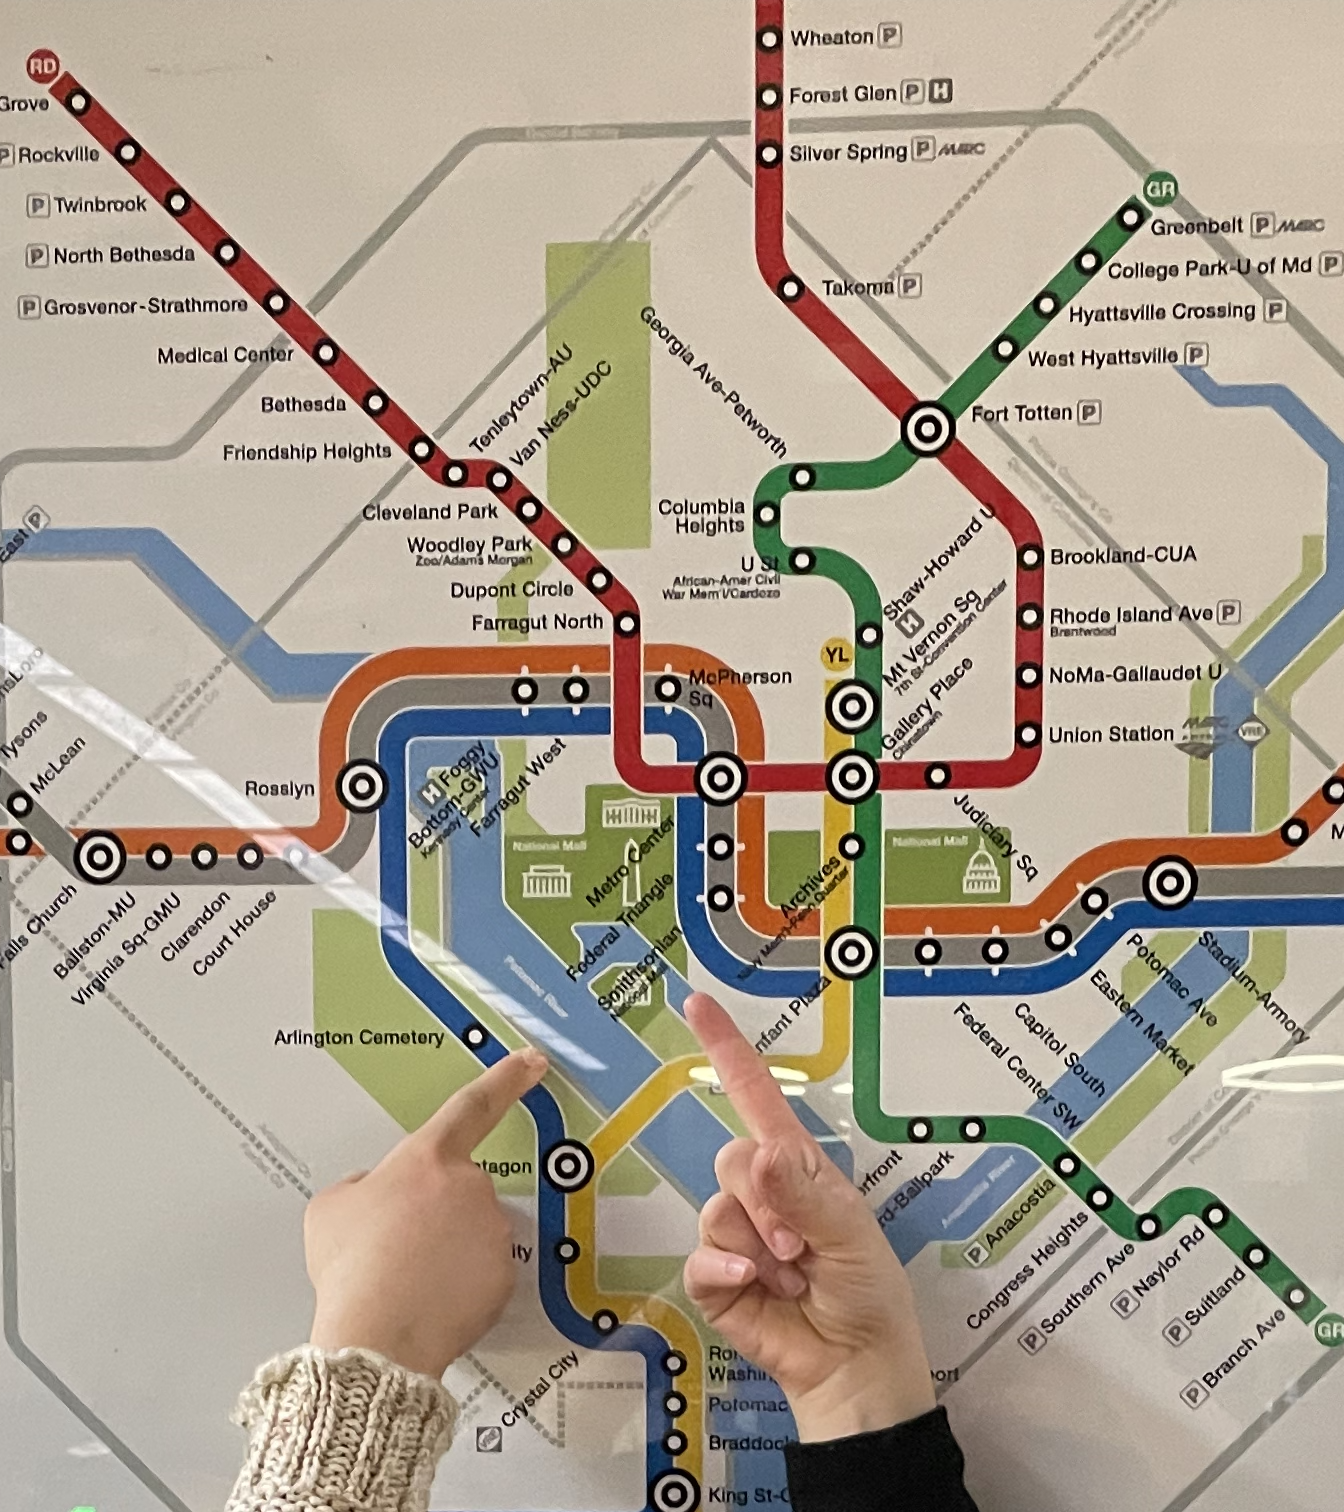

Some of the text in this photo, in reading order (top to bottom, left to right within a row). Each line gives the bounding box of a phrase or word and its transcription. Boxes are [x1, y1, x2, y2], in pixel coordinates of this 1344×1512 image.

[790, 28, 873, 47] Wheaton
[789, 83, 897, 104] Forest Glen
[19, 147, 99, 163] Rockville
[789, 142, 908, 165] Silver Spring
[54, 196, 147, 213] Twinbrook
[1151, 217, 1244, 237] Greenbelt
[822, 279, 895, 297] Takoma
[45, 299, 247, 316] Grosvenor-Strathmore
[1069, 301, 1256, 325] Hyattsville Crossing
[158, 346, 293, 364] Medical Center
[261, 396, 346, 413] Bethesda
[971, 403, 1073, 422] Fort Totten
[224, 443, 391, 463] Friendship Heights
[362, 503, 498, 521] Cleveland Park
[658, 499, 746, 517] Columbia
[675, 517, 745, 536] Heights
[407, 536, 532, 555] Woodley Park
[1050, 545, 1197, 566] Brookland-CUA
[450, 581, 574, 600] Dupont Circle
[1050, 606, 1214, 625] Rhode Island Ave
[1050, 626, 1117, 638] Brentwood
[689, 668, 792, 687] McPherson
[1049, 664, 1223, 684] NoMa-Gallaudet U
[689, 691, 713, 709] Sq
[881, 656, 974, 753] Gallery Place
[1049, 726, 1174, 744] Union Station
[30, 737, 86, 794] McLean
[245, 780, 315, 800] Rosslyn
[953, 794, 1039, 882] Judiciary Sq
[781, 855, 841, 918] Archives
[53, 891, 137, 980] Ballston-MU
[160, 891, 231, 964] Clarendon
[193, 890, 277, 977] Court House
[567, 872, 673, 983] Federal Triangle
[71, 892, 182, 1007] Virginia Sq-GMU
[598, 922, 683, 1011] Smithsonian
[1126, 932, 1220, 1029] Potomac Ave
[1197, 929, 1311, 1044] Stadium-Armory
[1089, 969, 1195, 1079] Eastern Market
[274, 1029, 445, 1048] Arlington Cemetery
[1013, 1002, 1109, 1100] Capitol South
[953, 1001, 1084, 1131] Federal Center SW
[985, 1176, 1057, 1250] Anacostia
[966, 1209, 1090, 1330] Congress Heights
[1041, 1241, 1136, 1336] Southern Ave
[1184, 1265, 1247, 1328] Suitland
[1201, 1307, 1287, 1389] Branch Ave
[501, 1349, 581, 1429] Crystal City
[709, 1398, 788, 1414] Potomac
